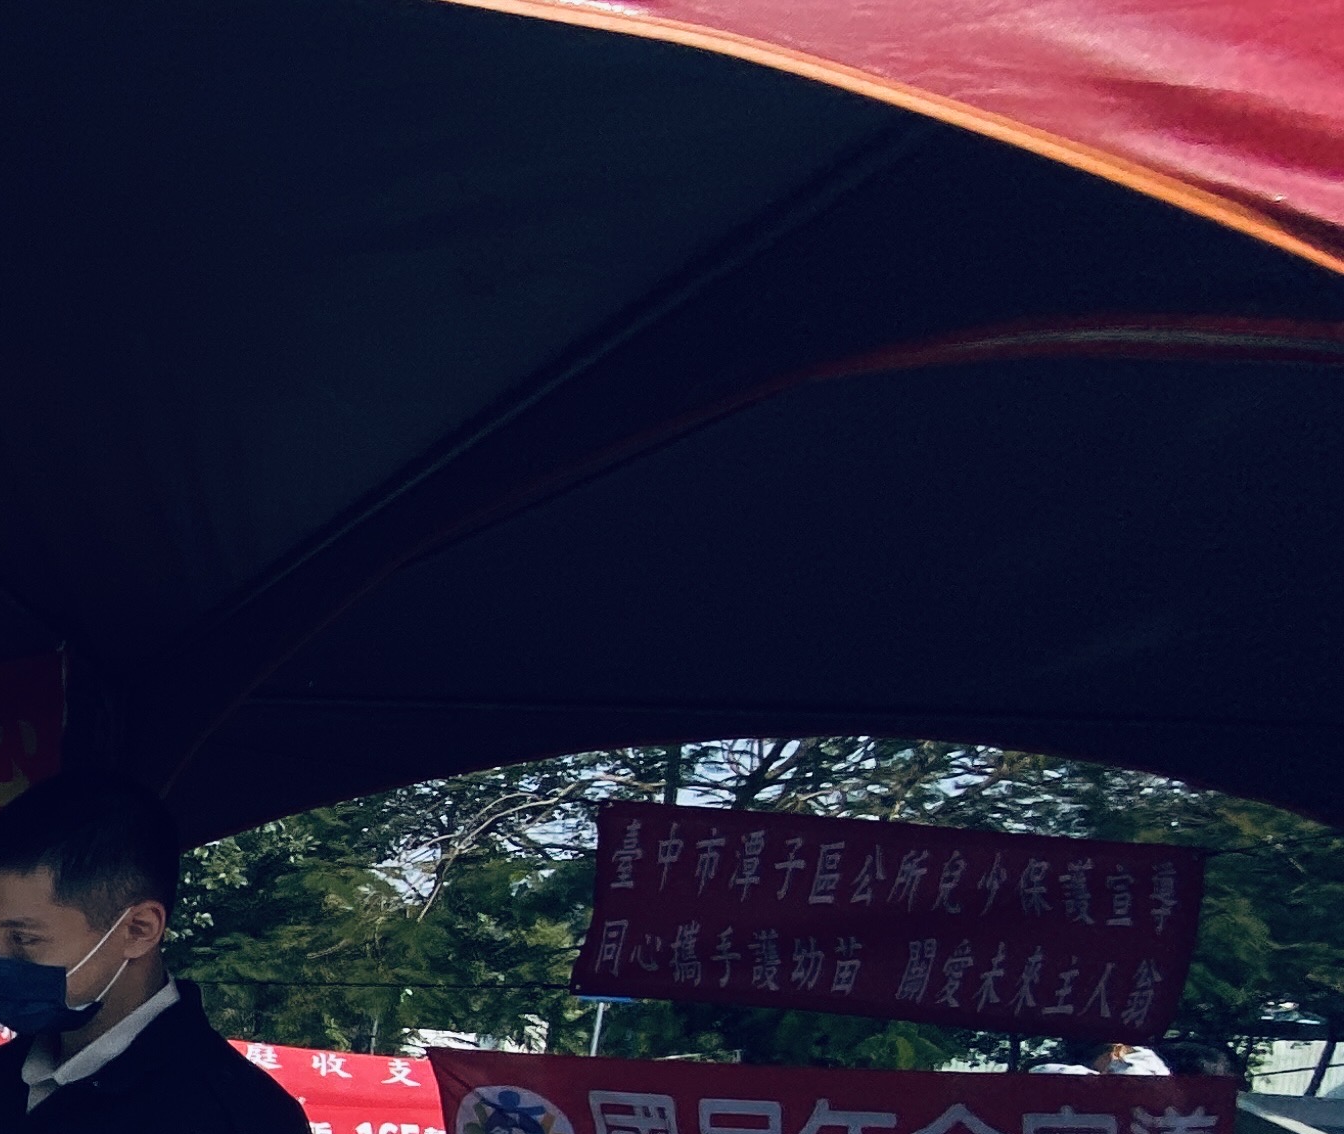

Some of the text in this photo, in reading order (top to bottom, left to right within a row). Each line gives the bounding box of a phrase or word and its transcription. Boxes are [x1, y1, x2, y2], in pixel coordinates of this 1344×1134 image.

[610, 818, 1183, 936] 臺中市潭子區公所兒少保護宣導
